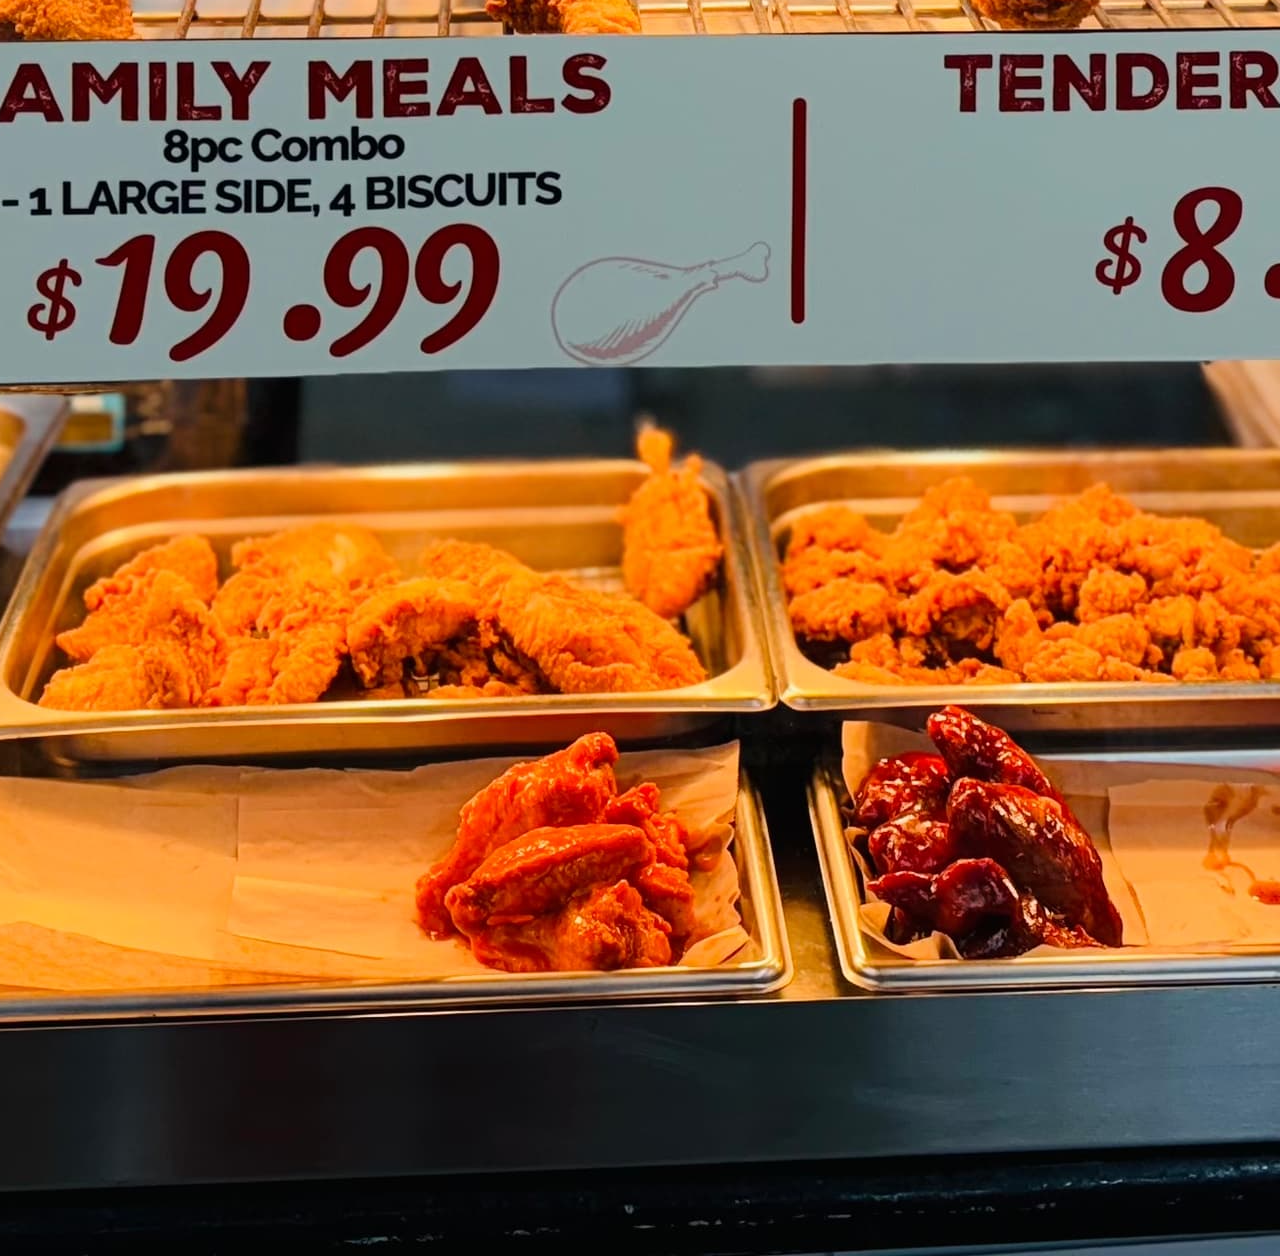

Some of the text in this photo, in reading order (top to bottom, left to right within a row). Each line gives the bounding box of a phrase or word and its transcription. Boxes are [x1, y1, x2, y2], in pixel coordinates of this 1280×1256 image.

[307, 52, 612, 121] MEALS
[162, 125, 406, 172] 8pc Combo
[28, 187, 53, 217] 1
[62, 178, 207, 216] LARGE
[214, 177, 321, 218] SIDE,
[328, 183, 357, 218] 4
[365, 170, 563, 211] BISCUITS
